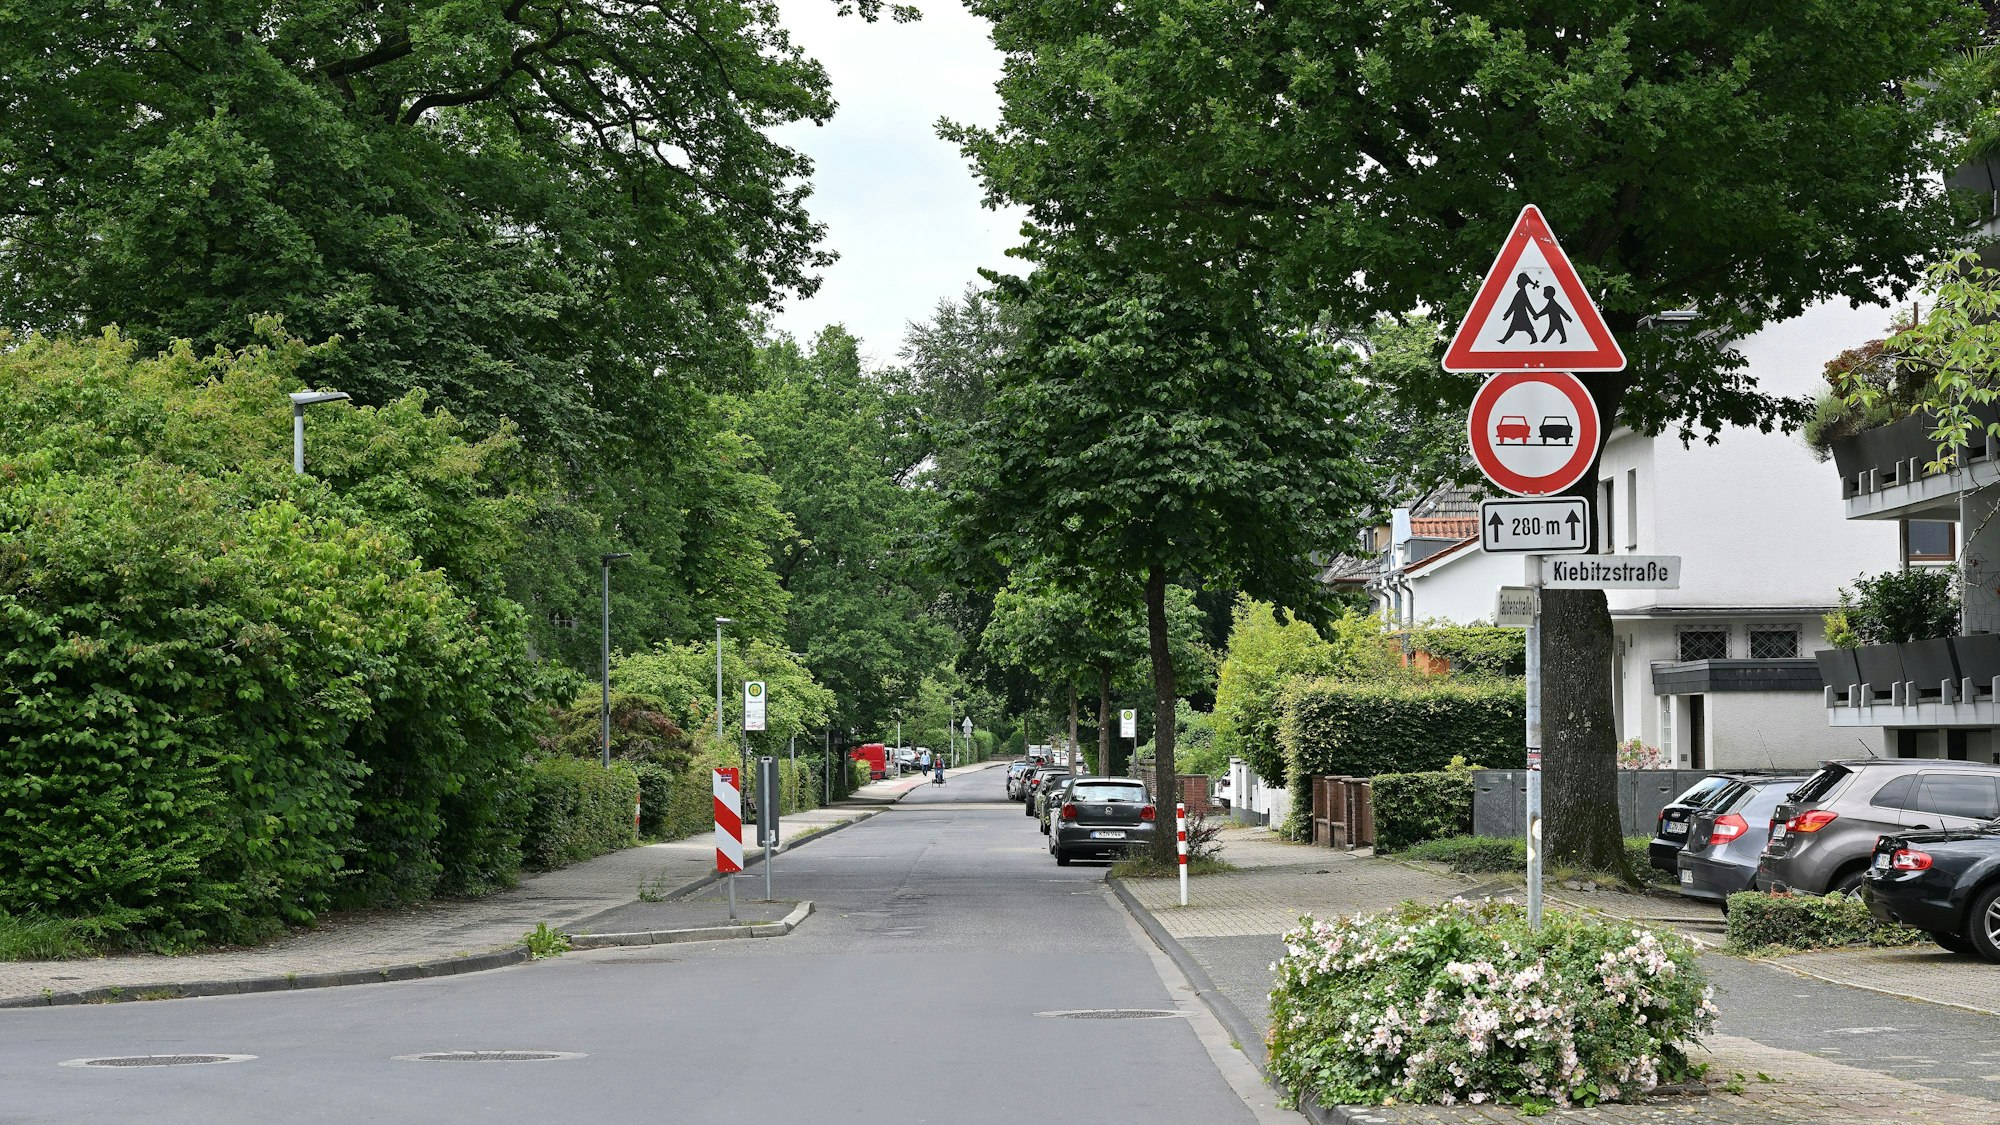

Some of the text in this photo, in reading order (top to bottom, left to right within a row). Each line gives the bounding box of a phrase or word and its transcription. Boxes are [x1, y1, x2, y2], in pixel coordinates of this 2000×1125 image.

[1512, 517, 1561, 536] 280 m
[1554, 561, 1668, 582] Kiebitzstraße
